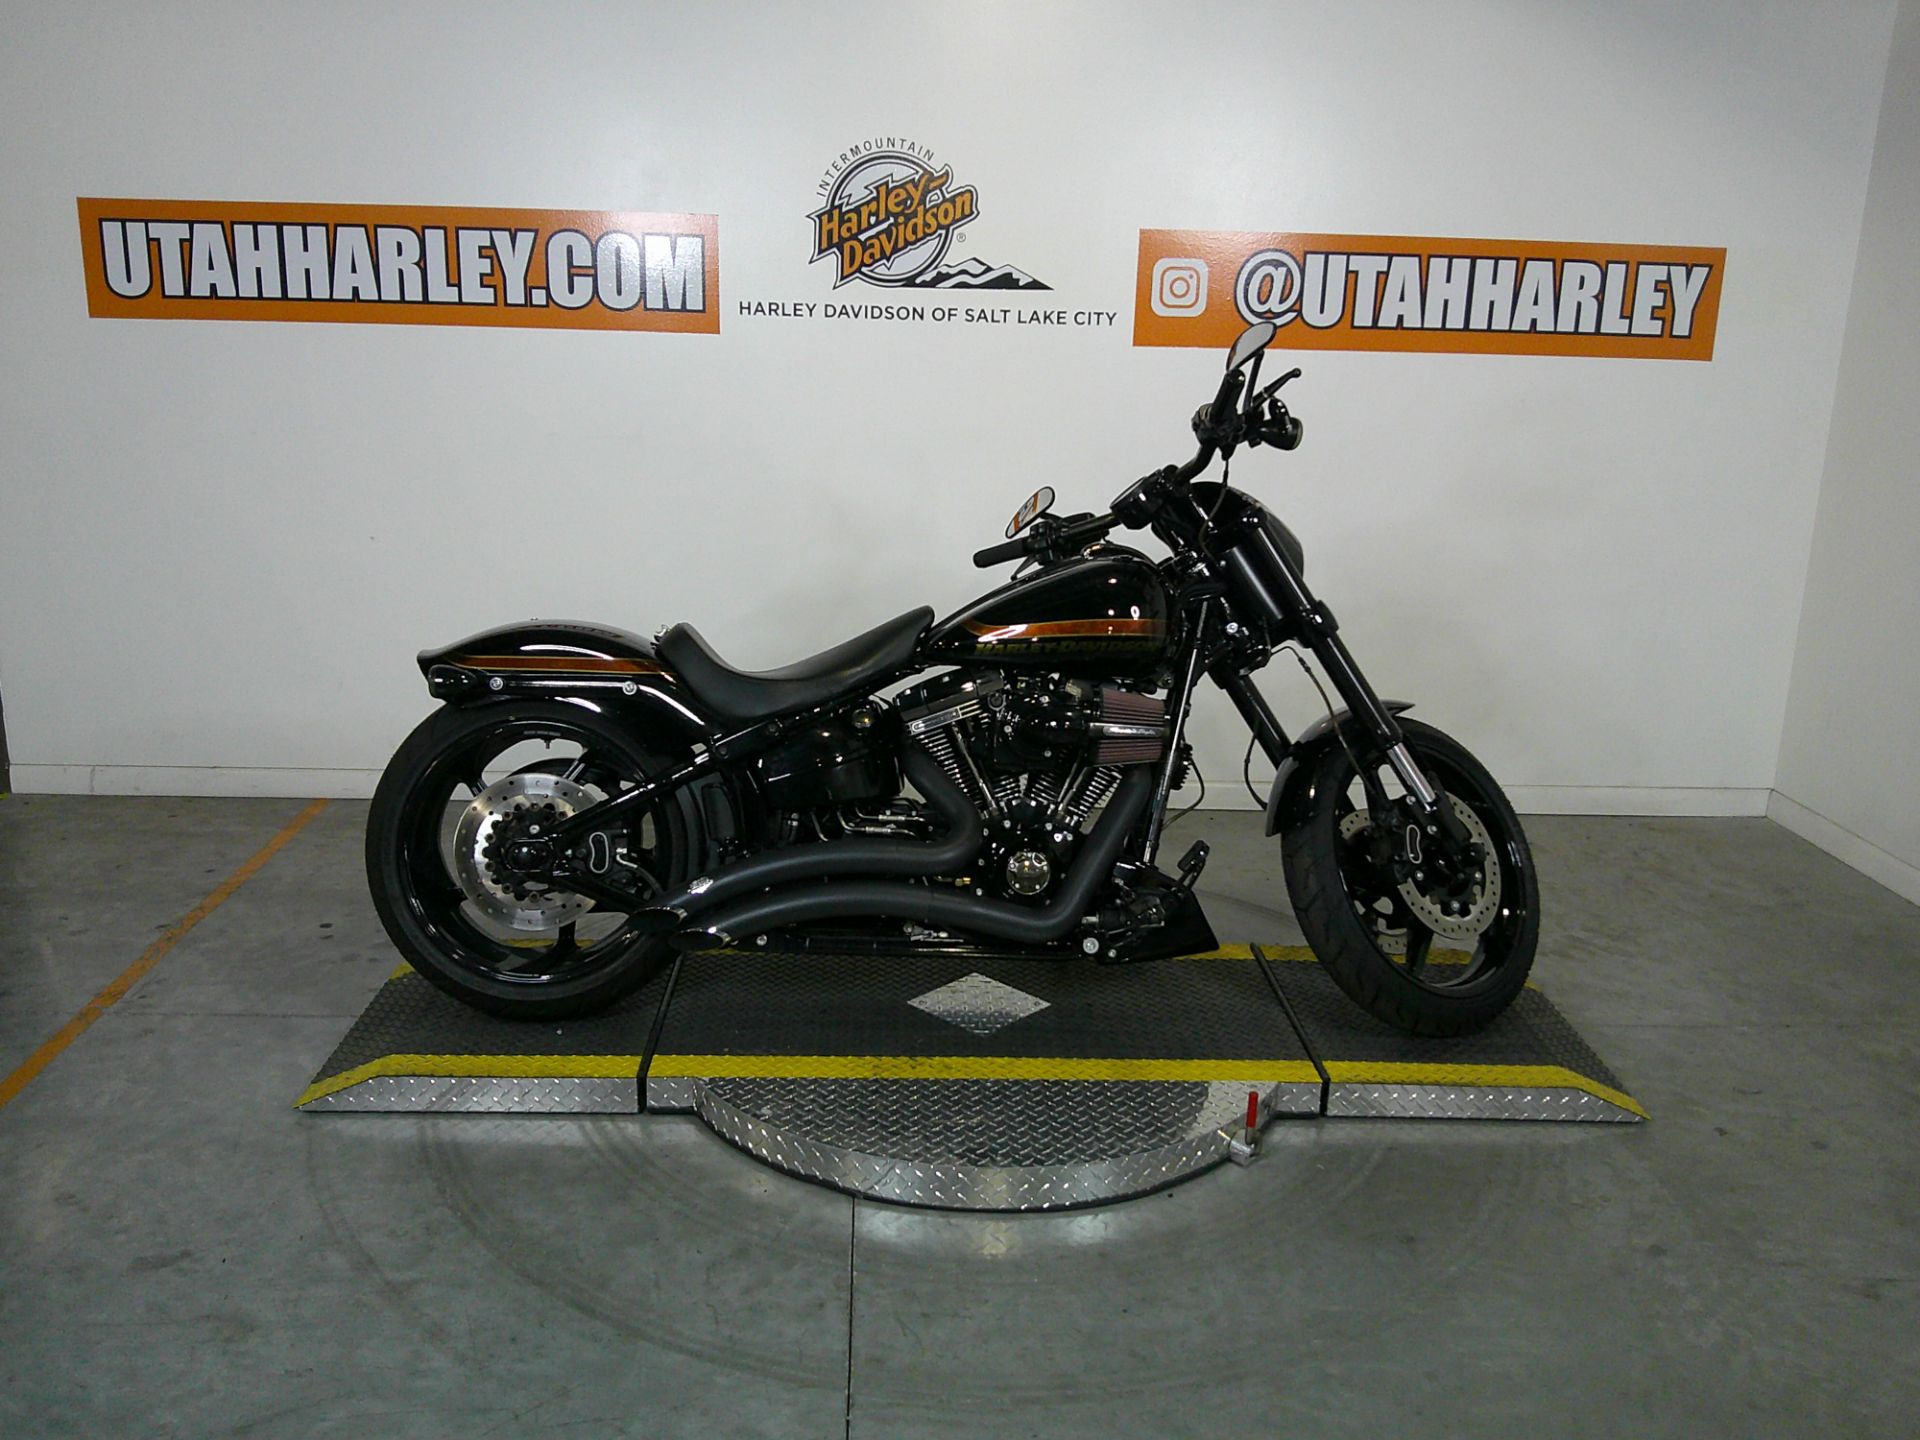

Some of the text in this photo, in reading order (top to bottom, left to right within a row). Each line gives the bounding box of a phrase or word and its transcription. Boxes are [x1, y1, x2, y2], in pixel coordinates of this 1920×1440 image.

[817, 137, 935, 197] INTERMOUNTAIN
[99, 217, 707, 314] UTAHHARLEY.COM
[840, 189, 973, 278] Davidson
[739, 301, 1118, 326] HARLEY DAVIDSON OF SALT LAKE CITY
[1234, 248, 1712, 338] @UTAHHARLEY
